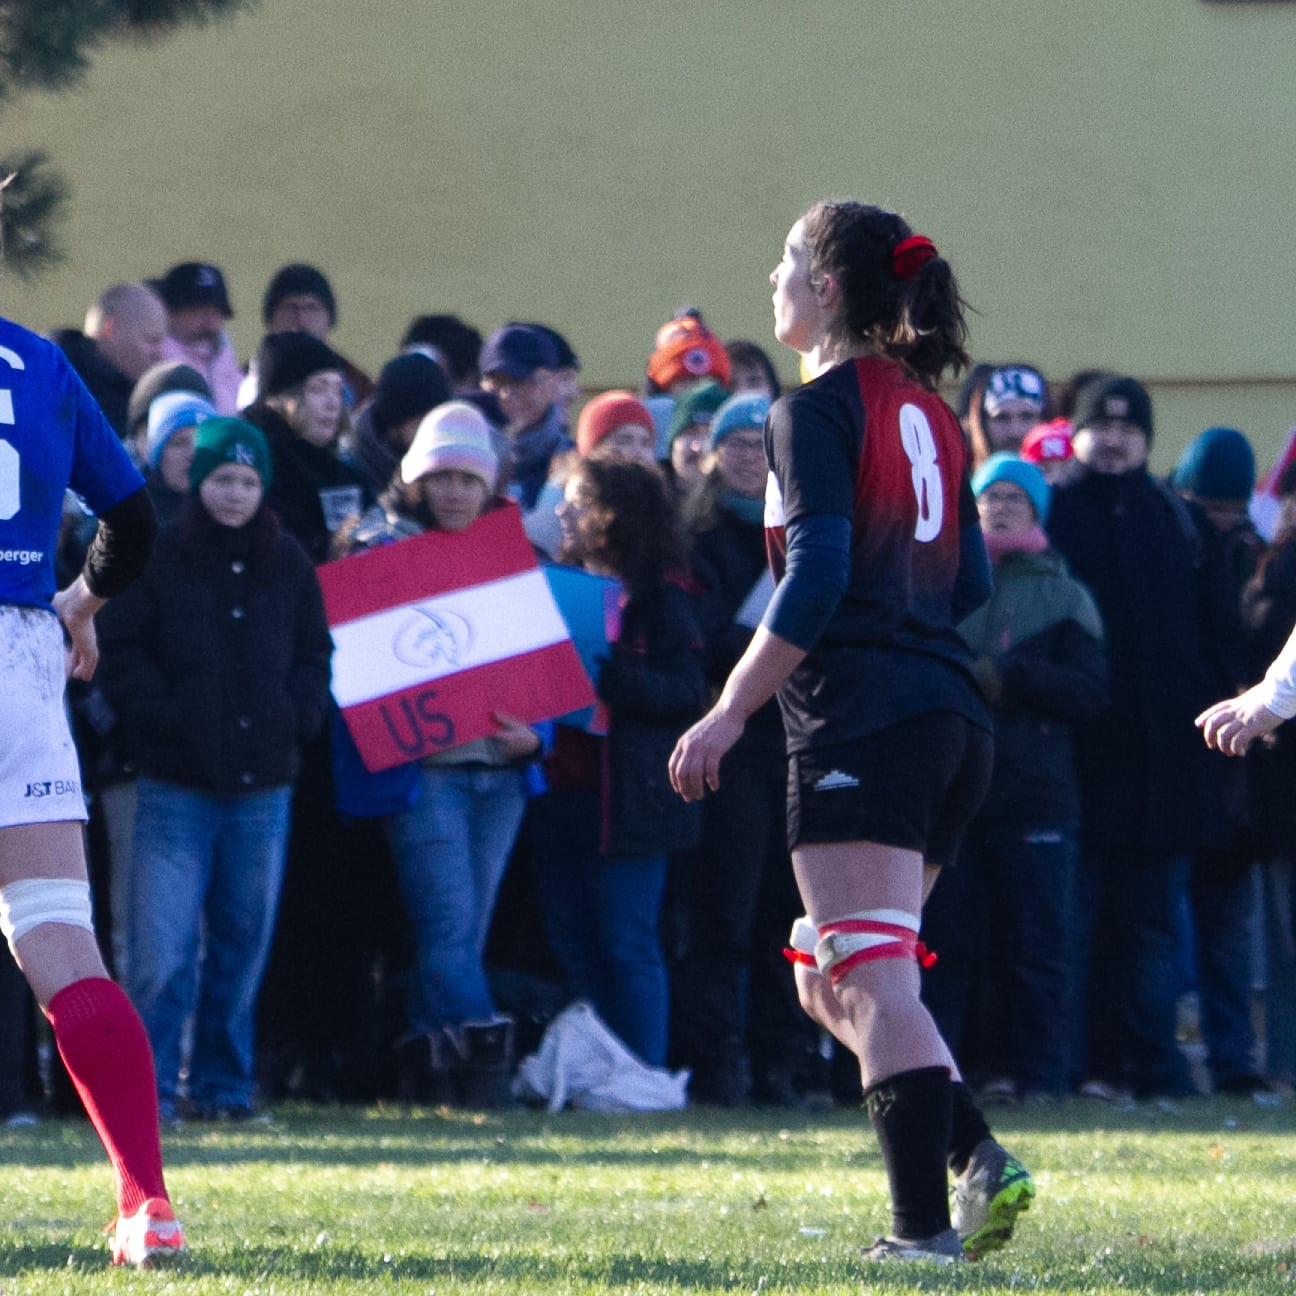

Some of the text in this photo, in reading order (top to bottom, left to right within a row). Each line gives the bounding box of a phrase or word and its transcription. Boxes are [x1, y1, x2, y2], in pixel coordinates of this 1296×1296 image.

[899, 403, 943, 542] 8
[378, 690, 456, 756] US
[24, 781, 51, 798] J&T
